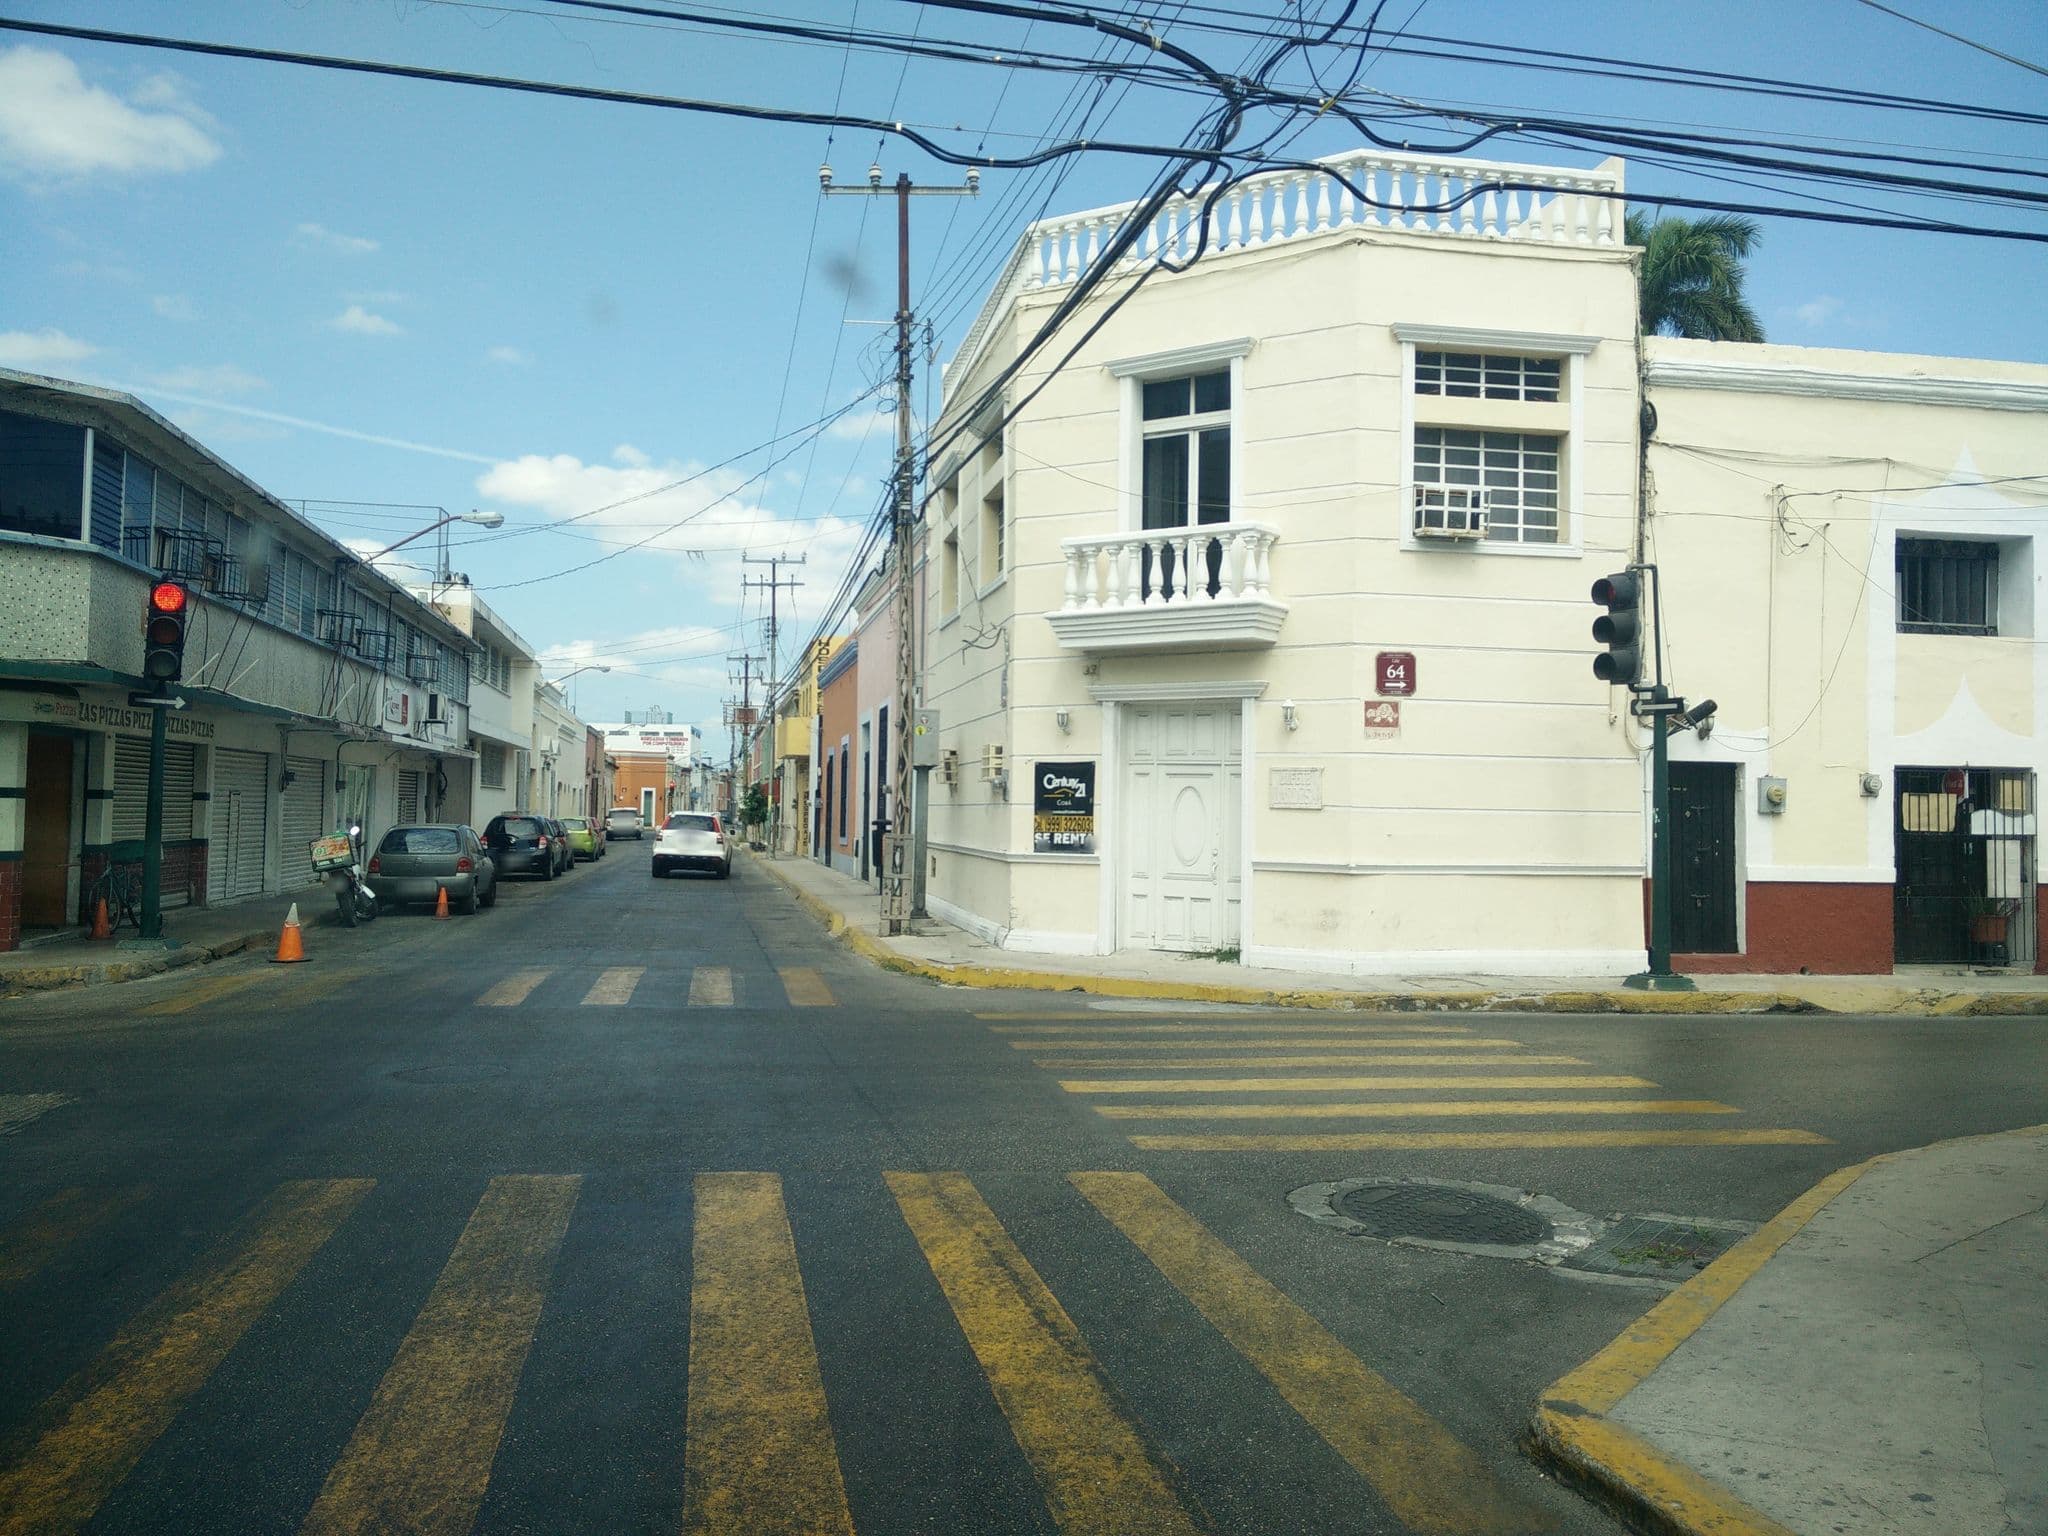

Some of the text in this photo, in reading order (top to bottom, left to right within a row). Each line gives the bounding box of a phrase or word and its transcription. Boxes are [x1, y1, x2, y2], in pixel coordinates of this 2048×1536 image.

[1386, 664, 1405, 679] 64
[99, 706, 132, 728] PIZZAS
[133, 710, 152, 731] PIZZ
[190, 719, 215, 739] PIZZAS
[1043, 773, 1079, 789] Century
[1074, 782, 1086, 797] 21
[1053, 832, 1095, 845] RENT
